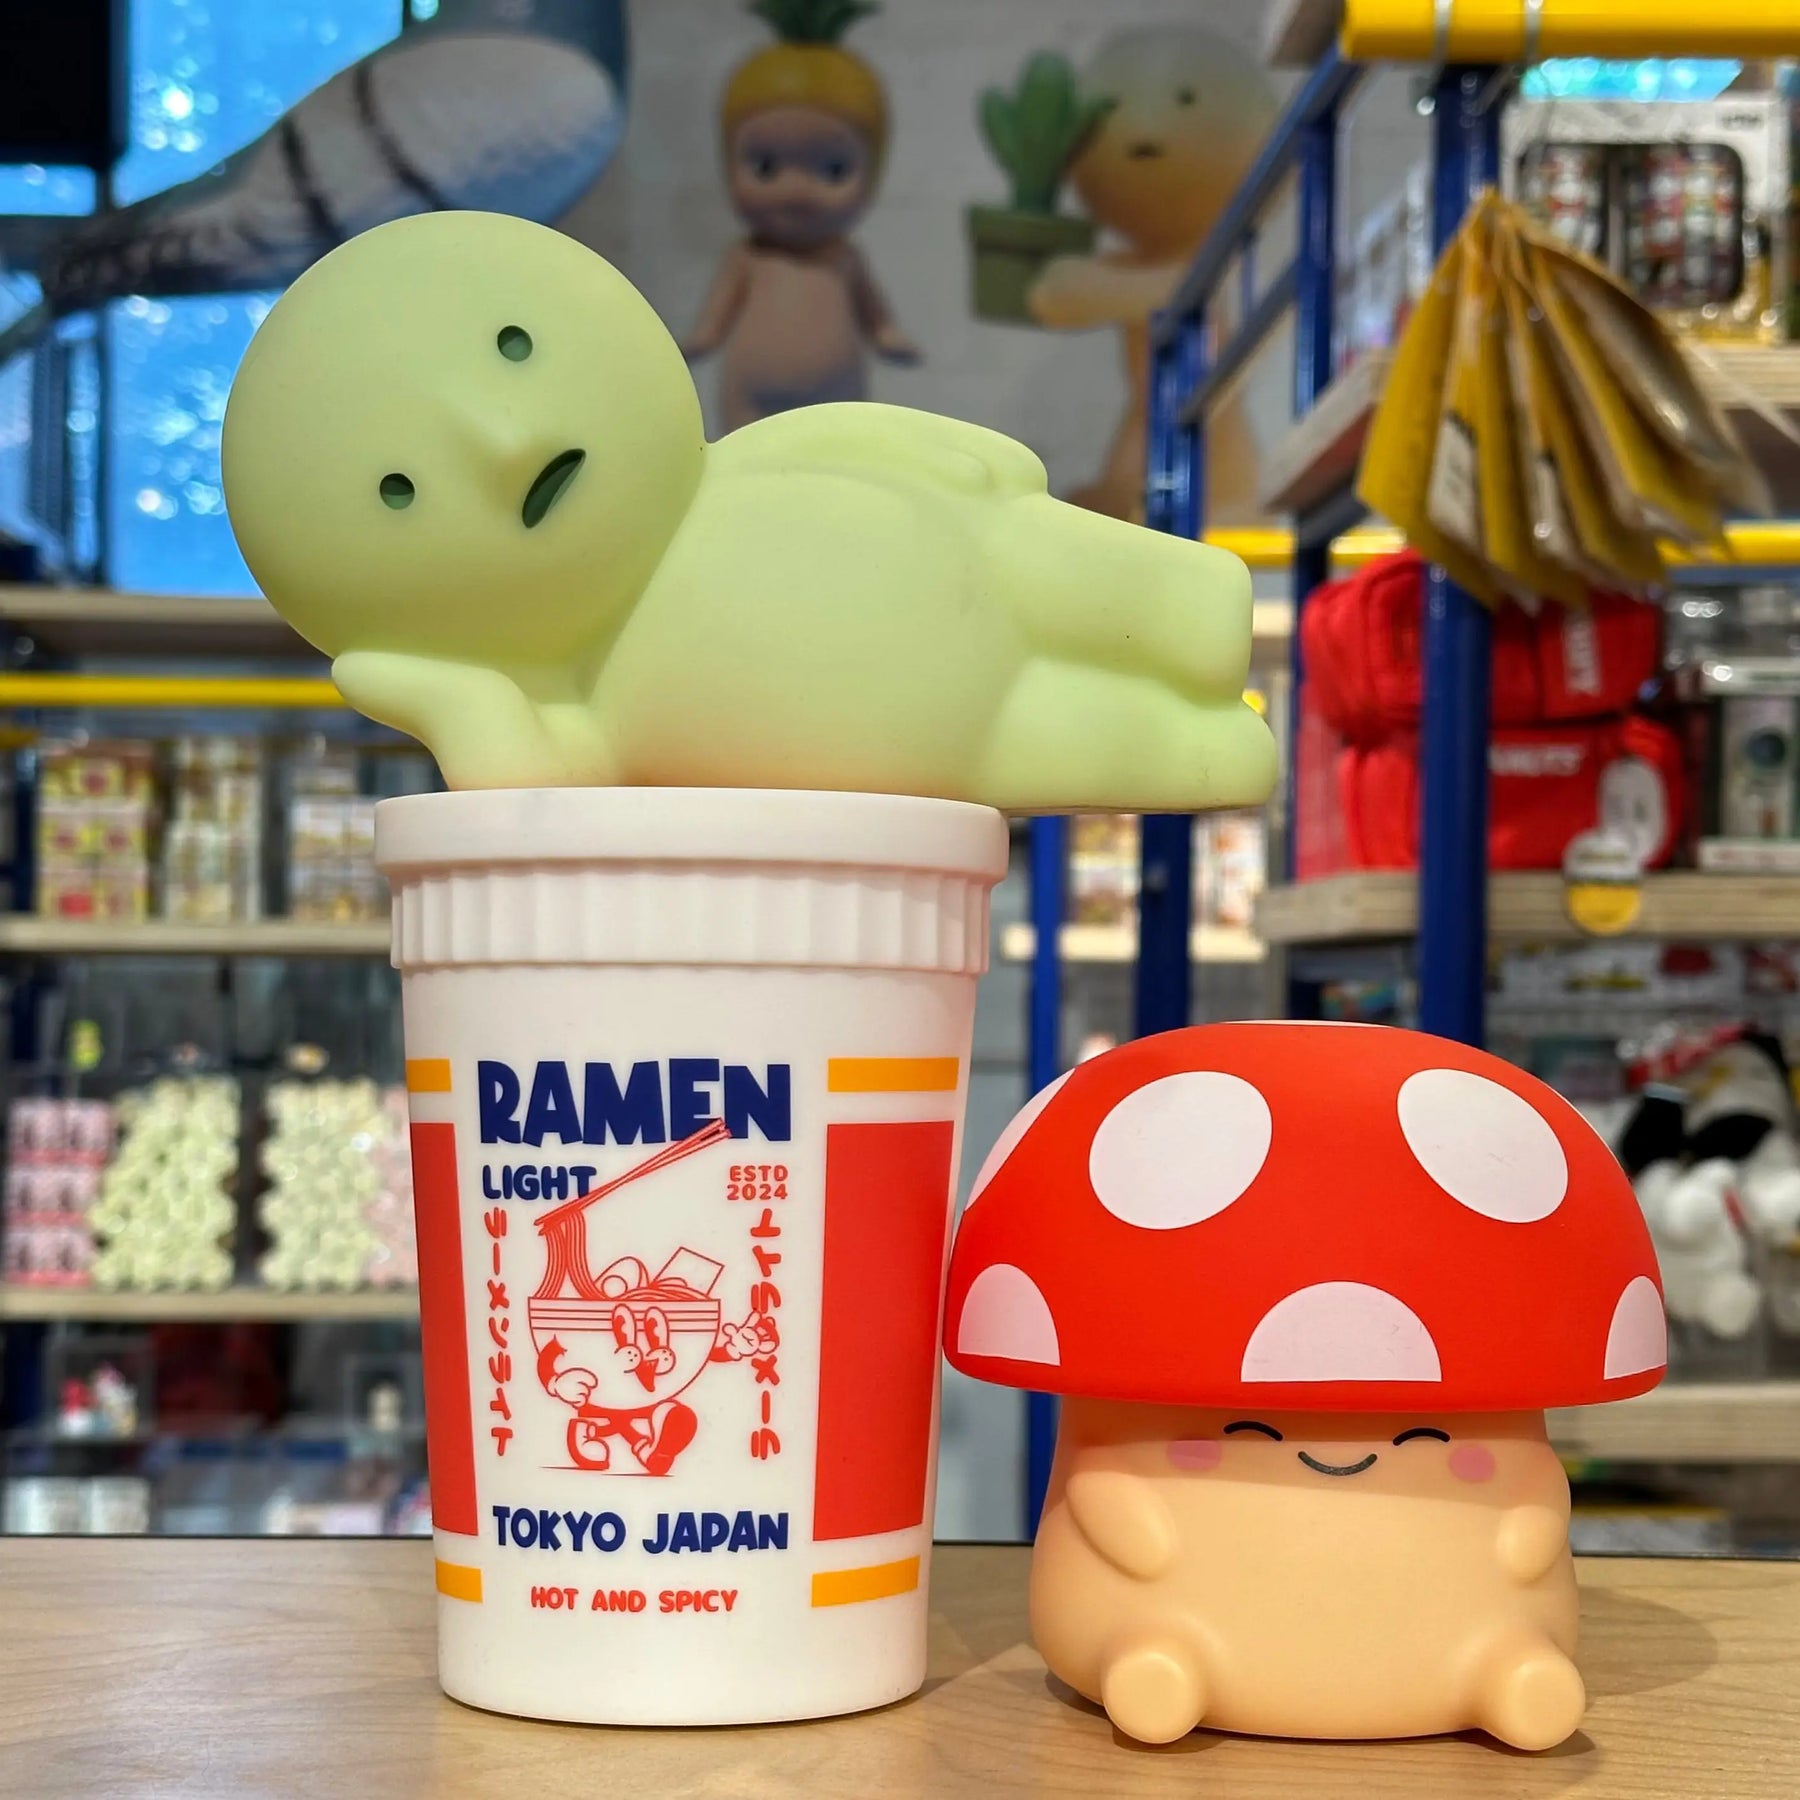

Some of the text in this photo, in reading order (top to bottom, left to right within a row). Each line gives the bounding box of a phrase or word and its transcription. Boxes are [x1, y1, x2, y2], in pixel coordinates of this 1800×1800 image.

[477, 1058, 791, 1146] RAMEN
[482, 1165, 597, 1200] LIGHT
[726, 1182, 789, 1202] 2024
[728, 1164, 789, 1183] ESTD
[483, 1207, 514, 1456] ラーメンライト
[749, 1207, 783, 1461] ラーメライト
[492, 1506, 789, 1555] TOKYO JAPAN
[530, 1586, 739, 1614] HOT AND SPICY
